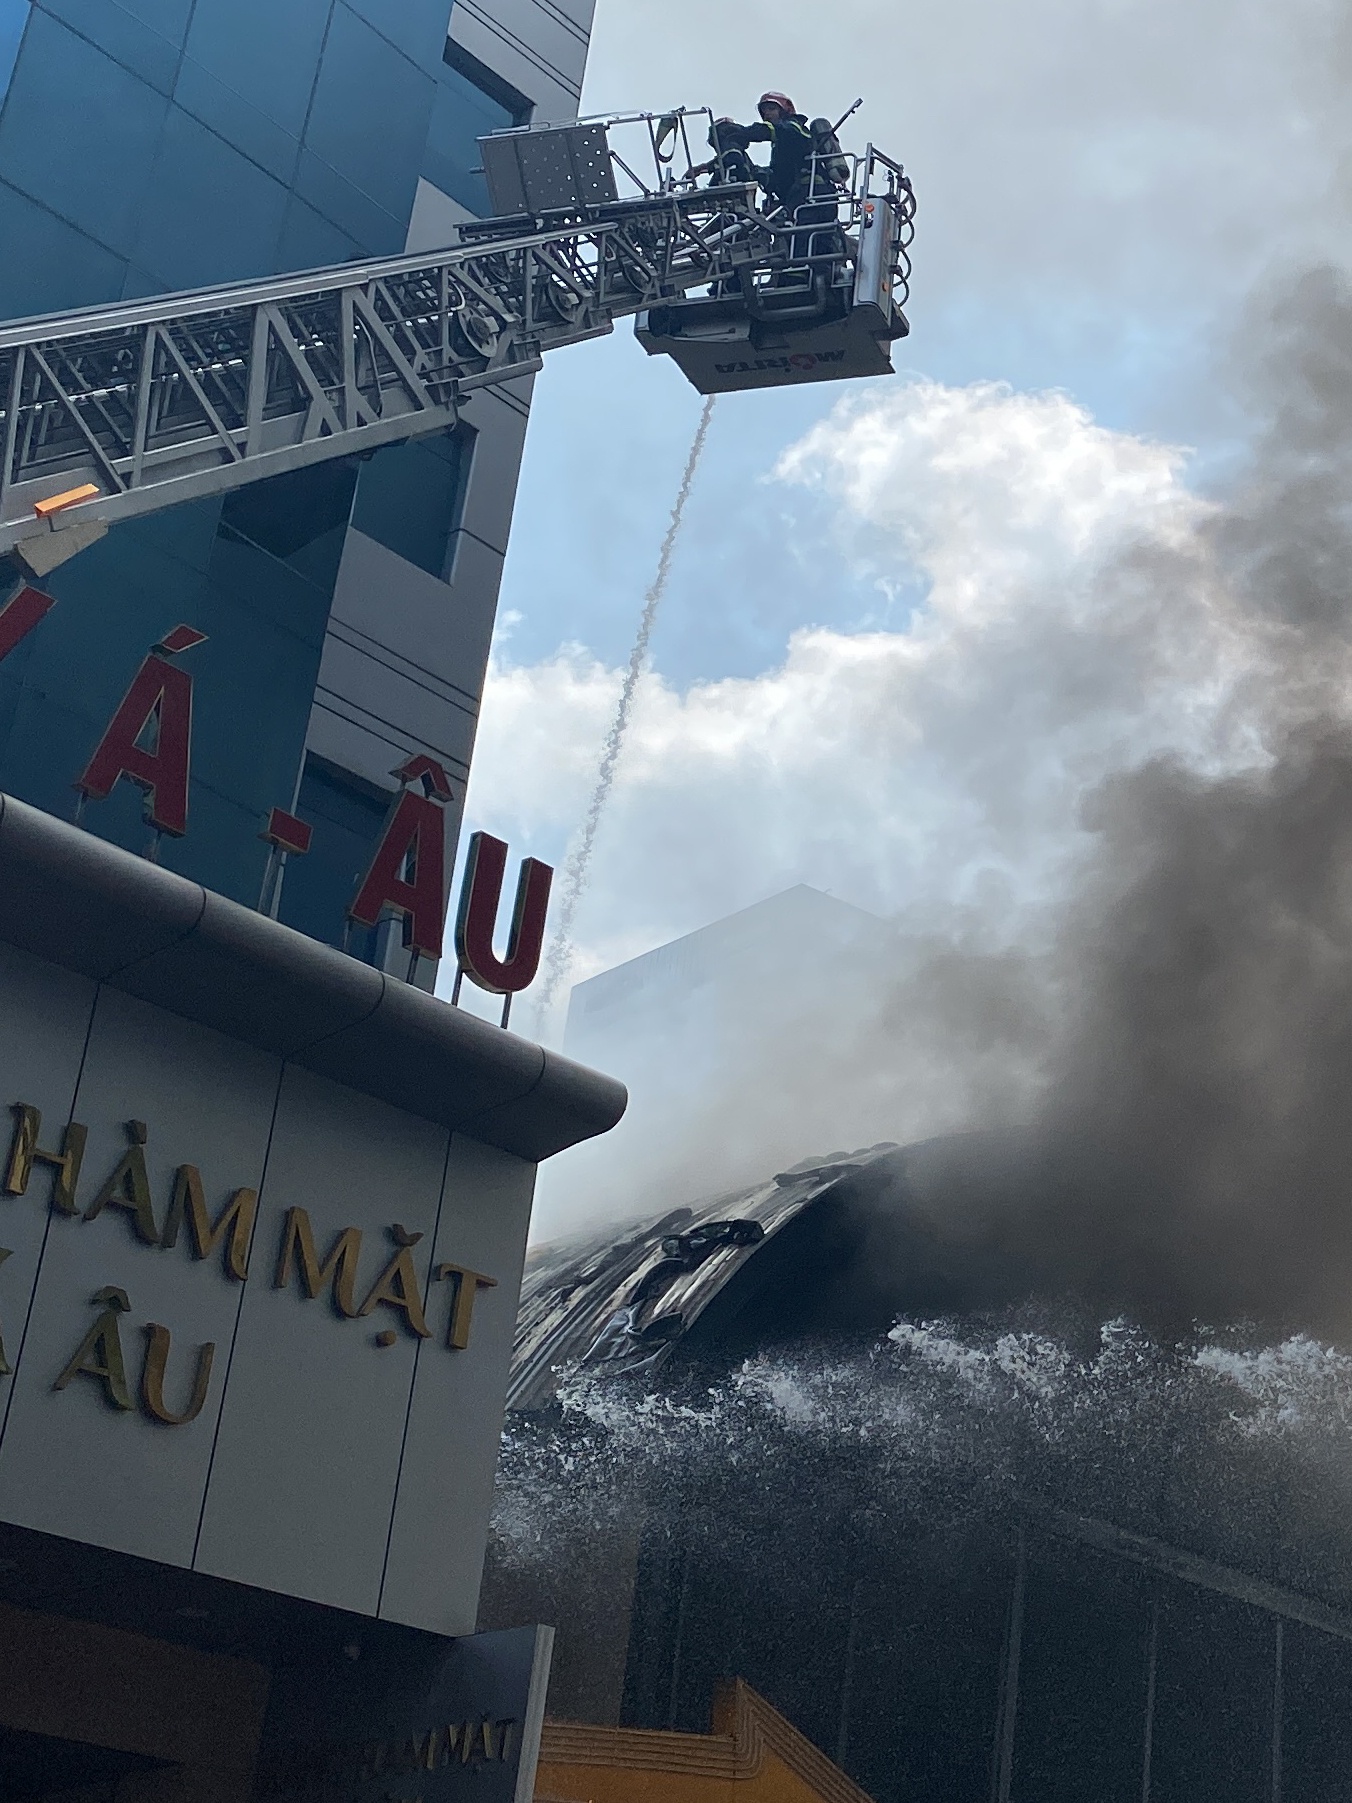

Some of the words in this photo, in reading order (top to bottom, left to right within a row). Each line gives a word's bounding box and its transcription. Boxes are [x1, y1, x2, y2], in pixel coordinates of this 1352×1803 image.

[72, 624, 208, 838] Á
[347, 754, 554, 994] ÂU
[272, 1206, 498, 1349] MẶT
[51, 1285, 215, 1424] ÂU
